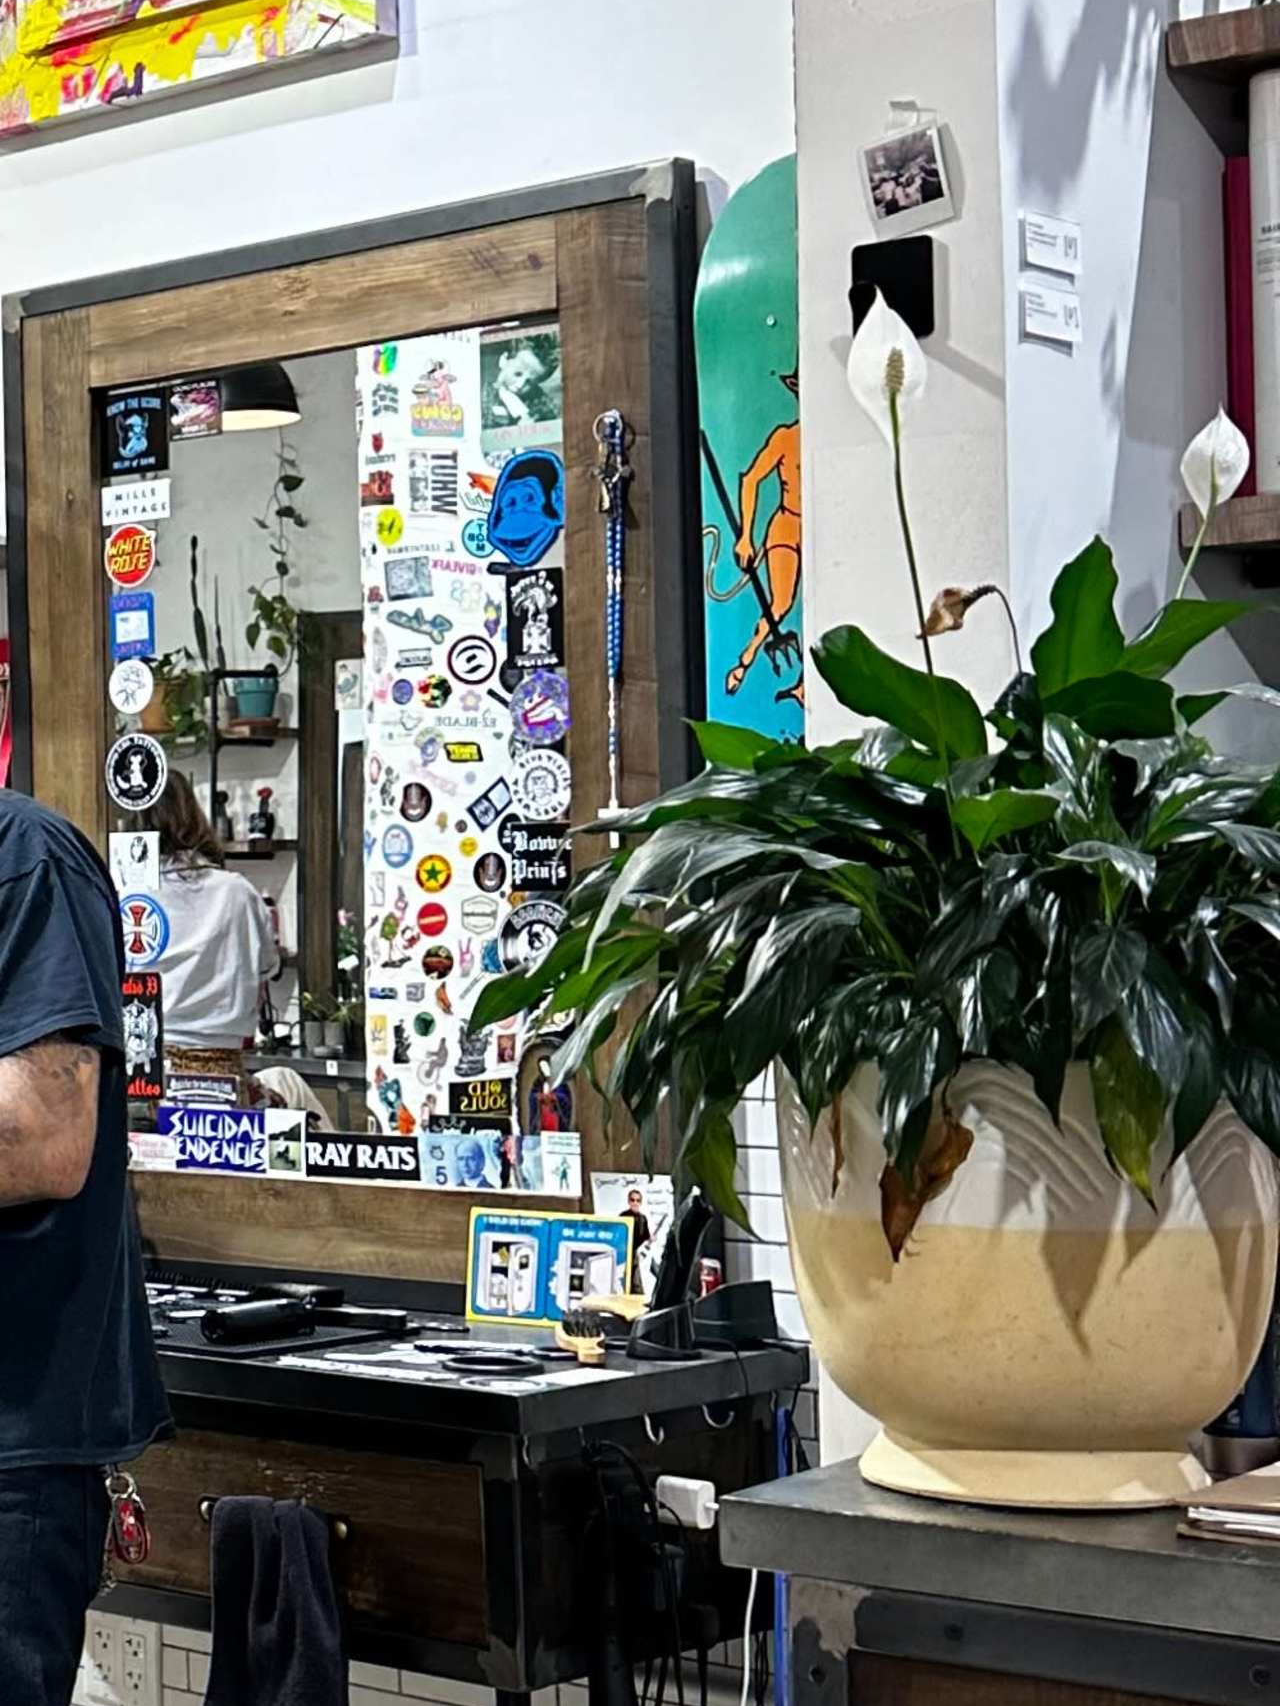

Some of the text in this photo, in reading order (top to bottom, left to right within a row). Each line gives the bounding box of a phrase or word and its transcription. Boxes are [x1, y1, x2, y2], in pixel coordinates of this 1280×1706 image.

[115, 486, 157, 502] MILLS
[105, 502, 167, 519] VINTAGE
[108, 533, 152, 558] WHITE
[111, 551, 148, 574] ROSE
[126, 1077, 161, 1097] attoo
[167, 1110, 266, 1141] SUICIDAL
[174, 1133, 268, 1171] ENDENCIES
[356, 1145, 418, 1172] RATS
[435, 1165, 449, 1186] 5
